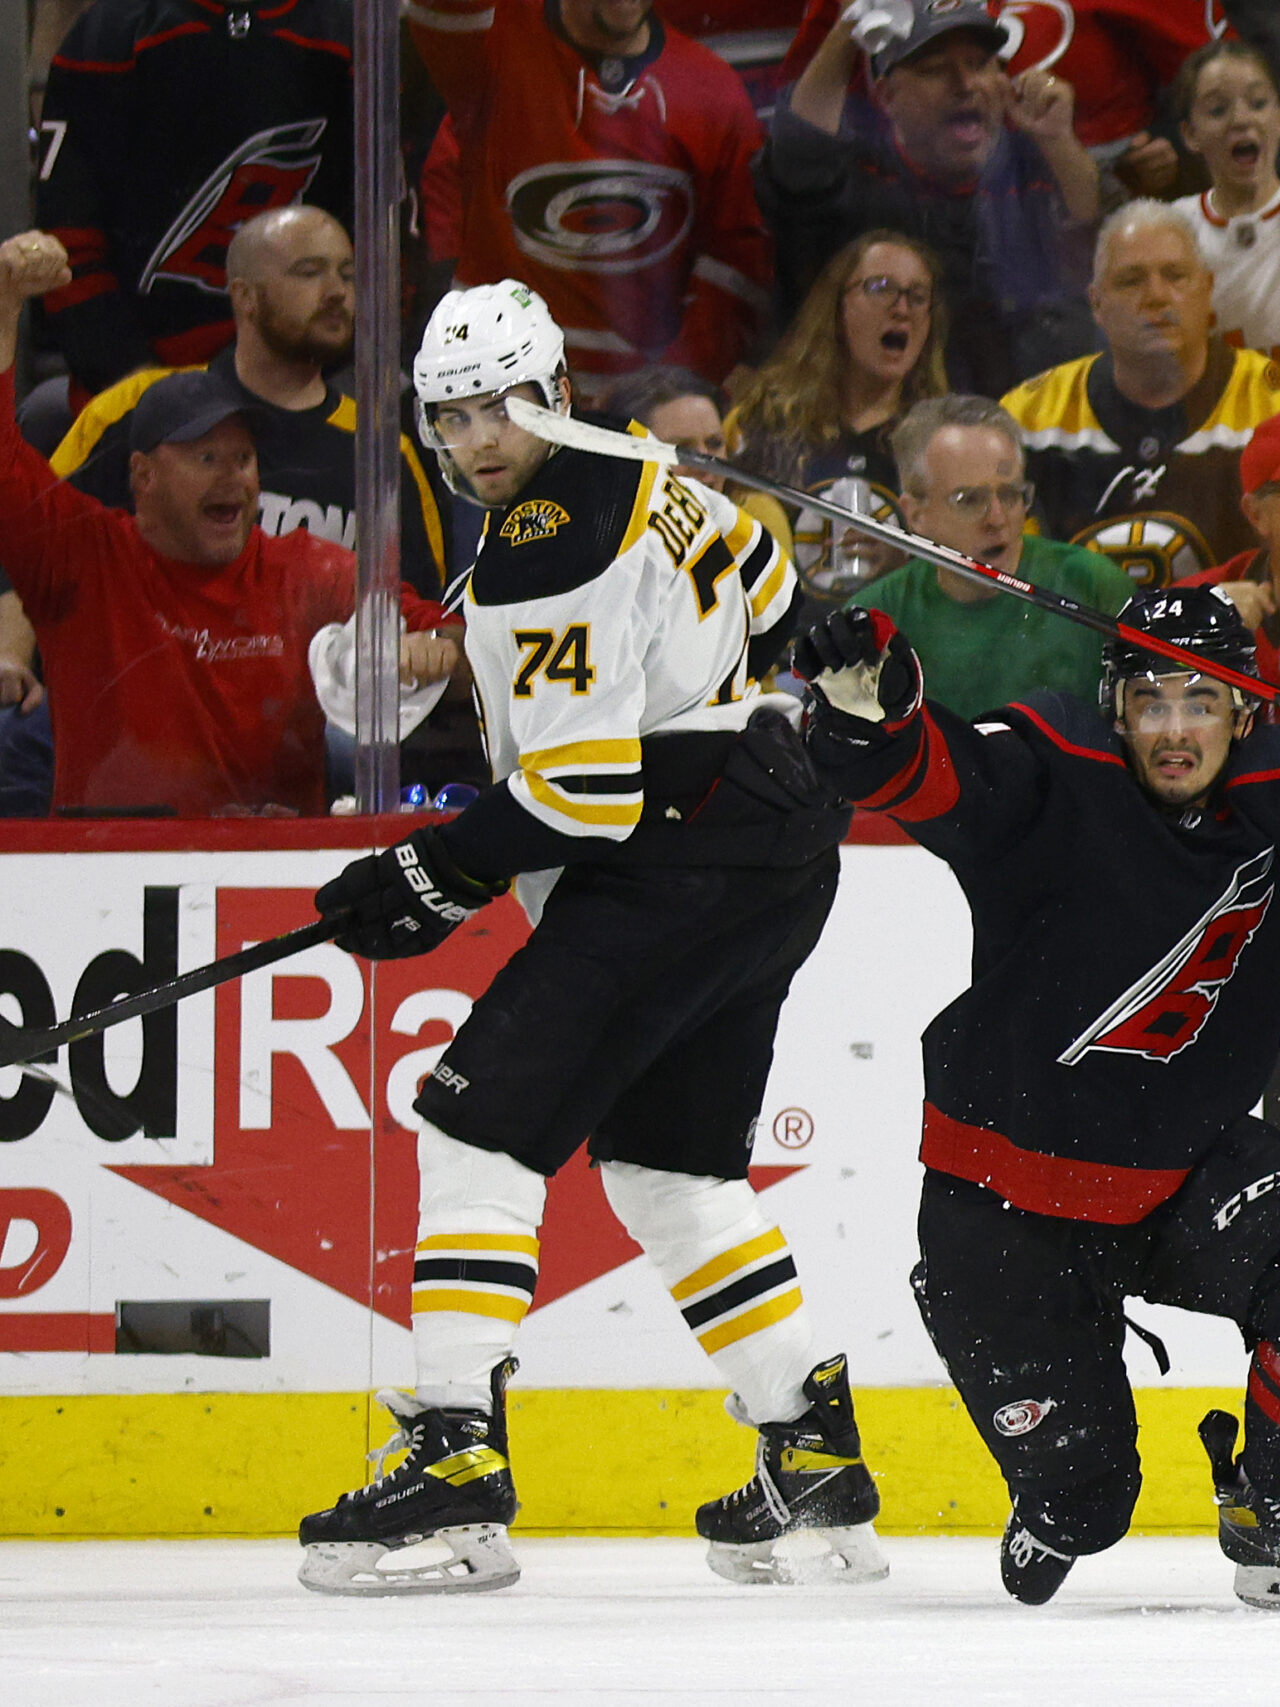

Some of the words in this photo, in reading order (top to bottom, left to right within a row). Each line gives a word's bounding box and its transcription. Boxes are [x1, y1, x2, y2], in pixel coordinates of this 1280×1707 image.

[502, 501, 569, 534] BOSTON
[647, 468, 709, 570] DEB
[1152, 598, 1184, 620] 24
[511, 622, 595, 699] 74
[375, 1482, 425, 1509] BAUER
